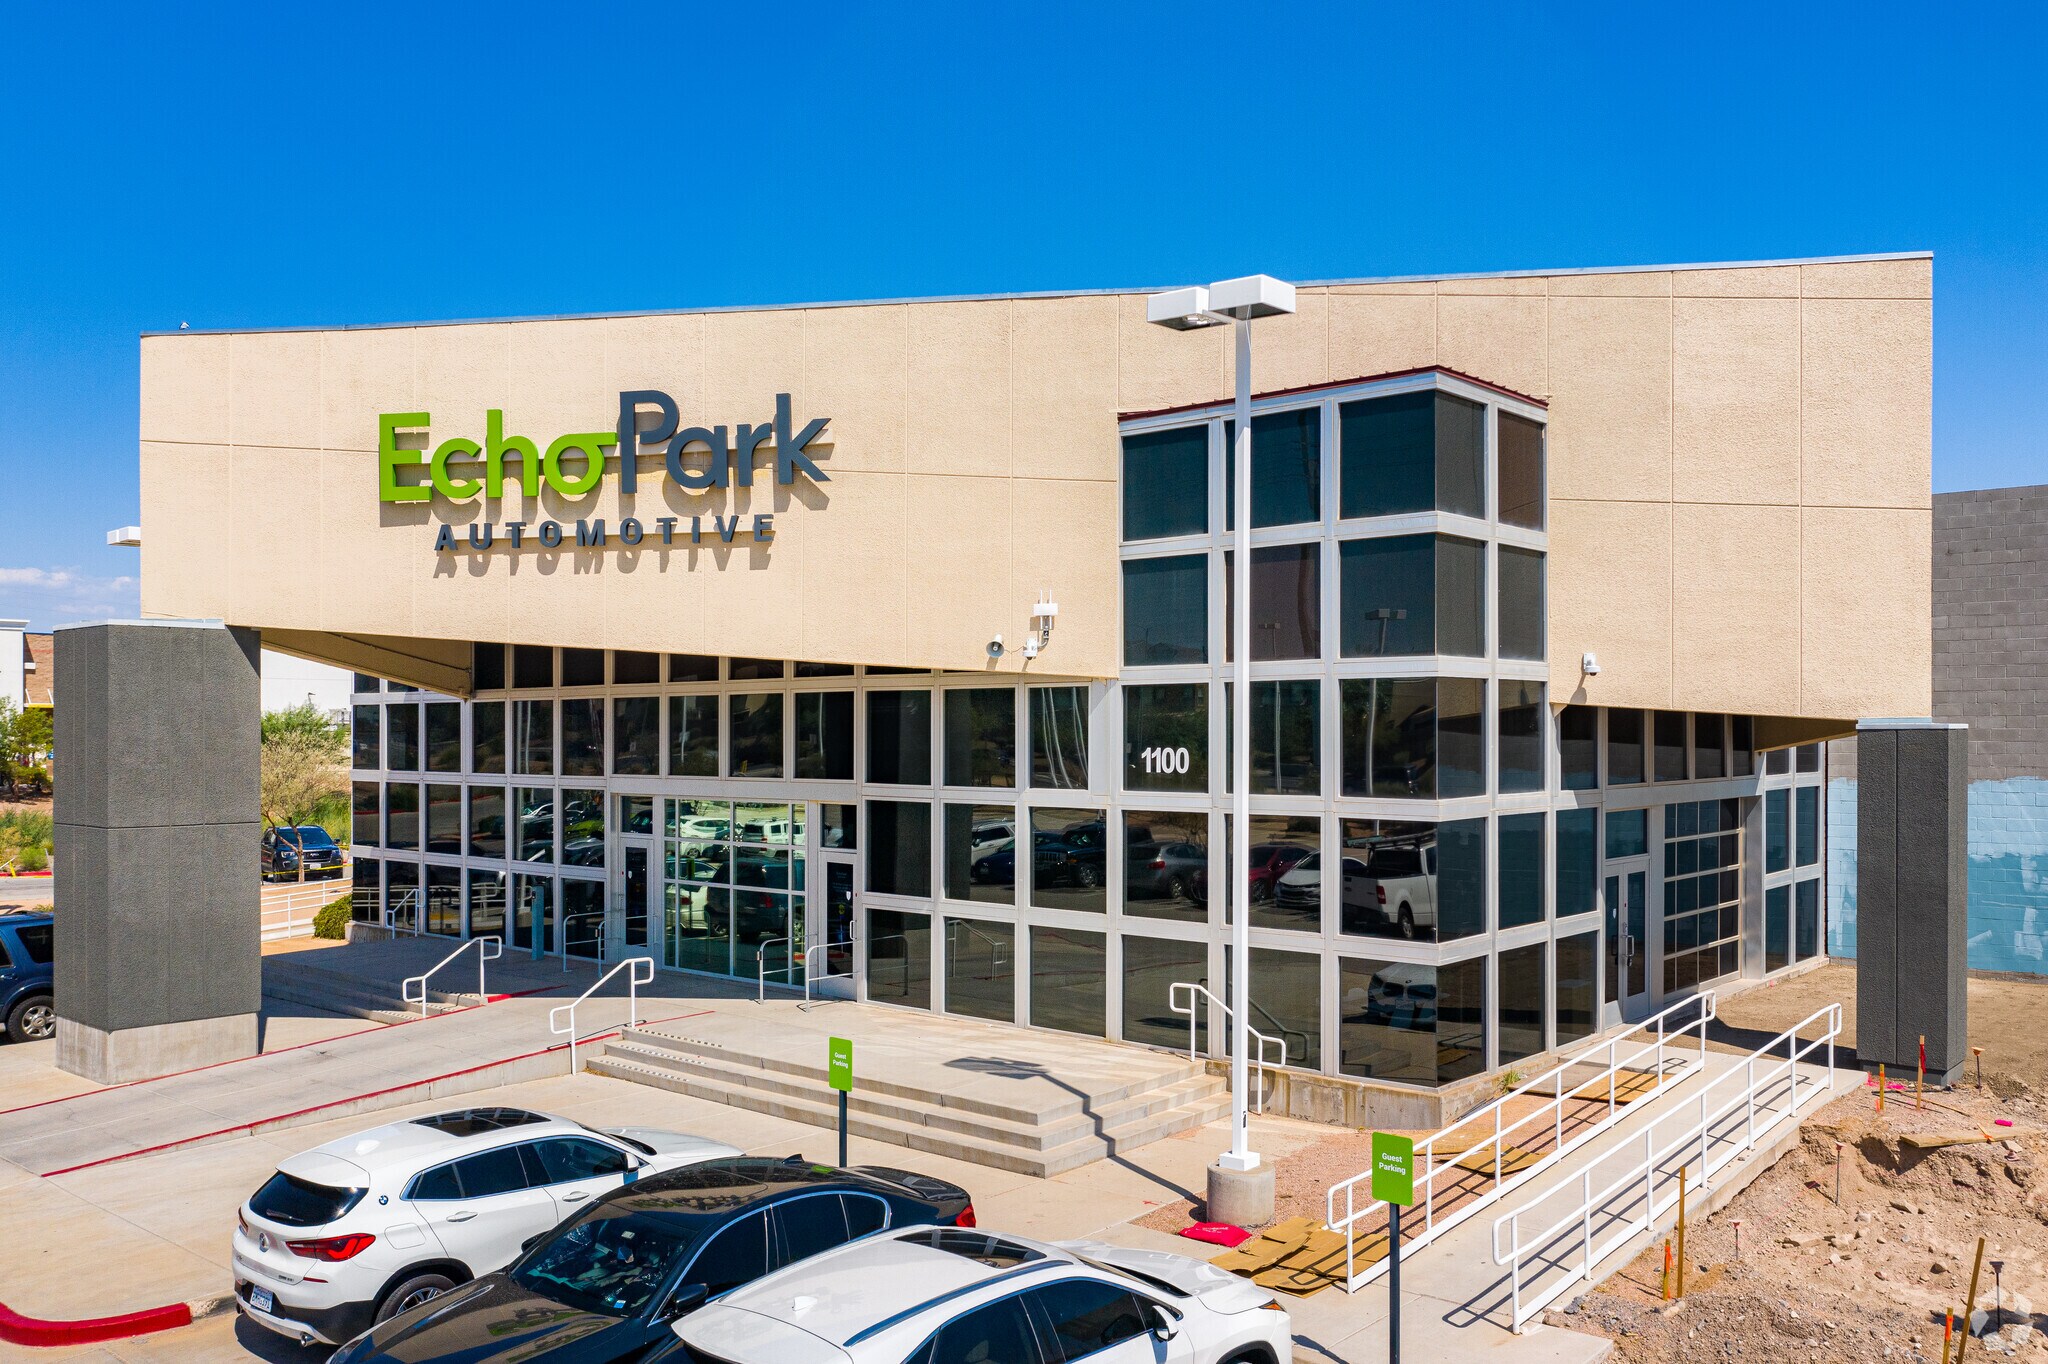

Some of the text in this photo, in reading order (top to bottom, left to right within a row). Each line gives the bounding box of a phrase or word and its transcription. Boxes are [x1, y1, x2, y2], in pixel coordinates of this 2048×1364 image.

[379, 389, 832, 502] EchoPark
[434, 513, 775, 552] AUTOMOTIVE
[1141, 747, 1190, 774] 1100
[1378, 1162, 1406, 1175] Parking
[1381, 1152, 1403, 1163] Guest
